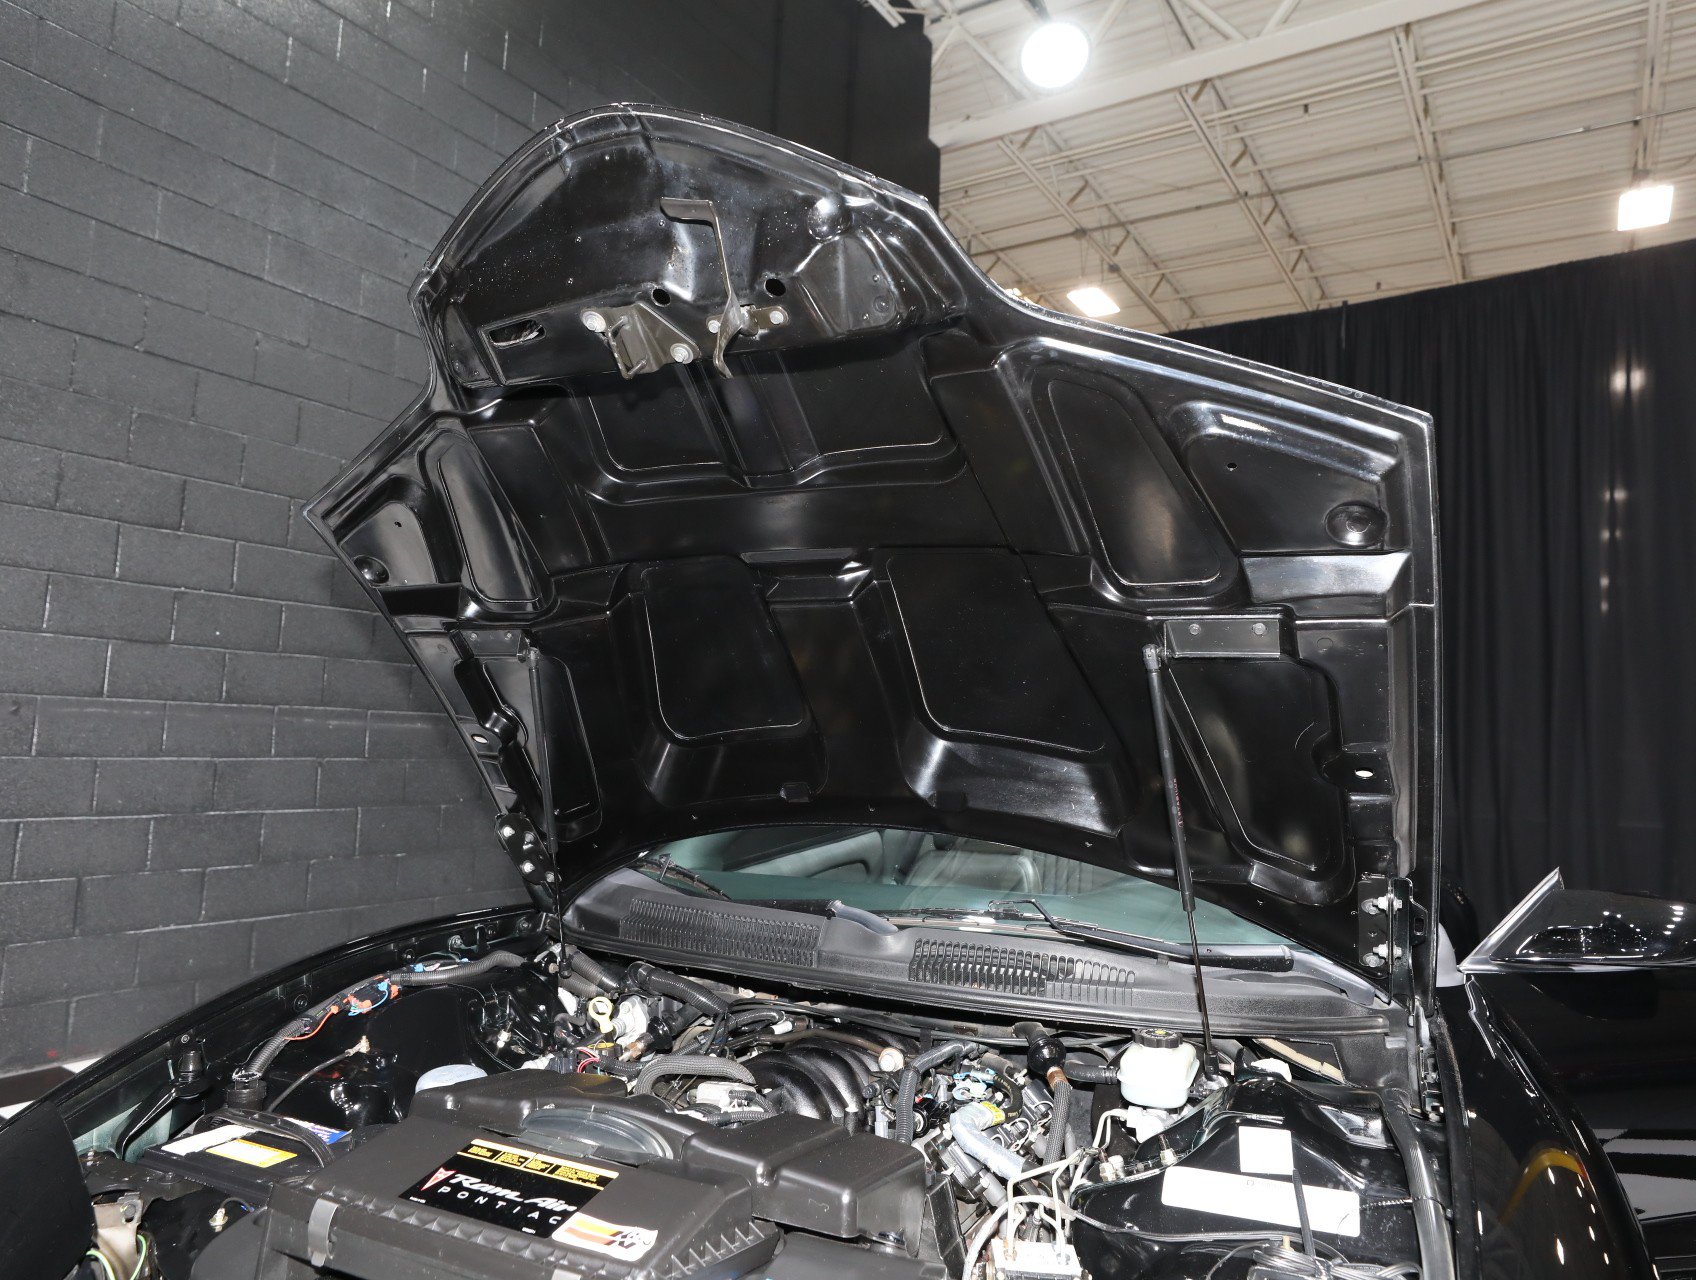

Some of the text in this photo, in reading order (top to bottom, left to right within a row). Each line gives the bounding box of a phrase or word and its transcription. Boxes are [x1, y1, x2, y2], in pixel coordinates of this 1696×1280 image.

[438, 1185, 562, 1225] PONTIAC
[449, 1173, 578, 1212] Ram Air
